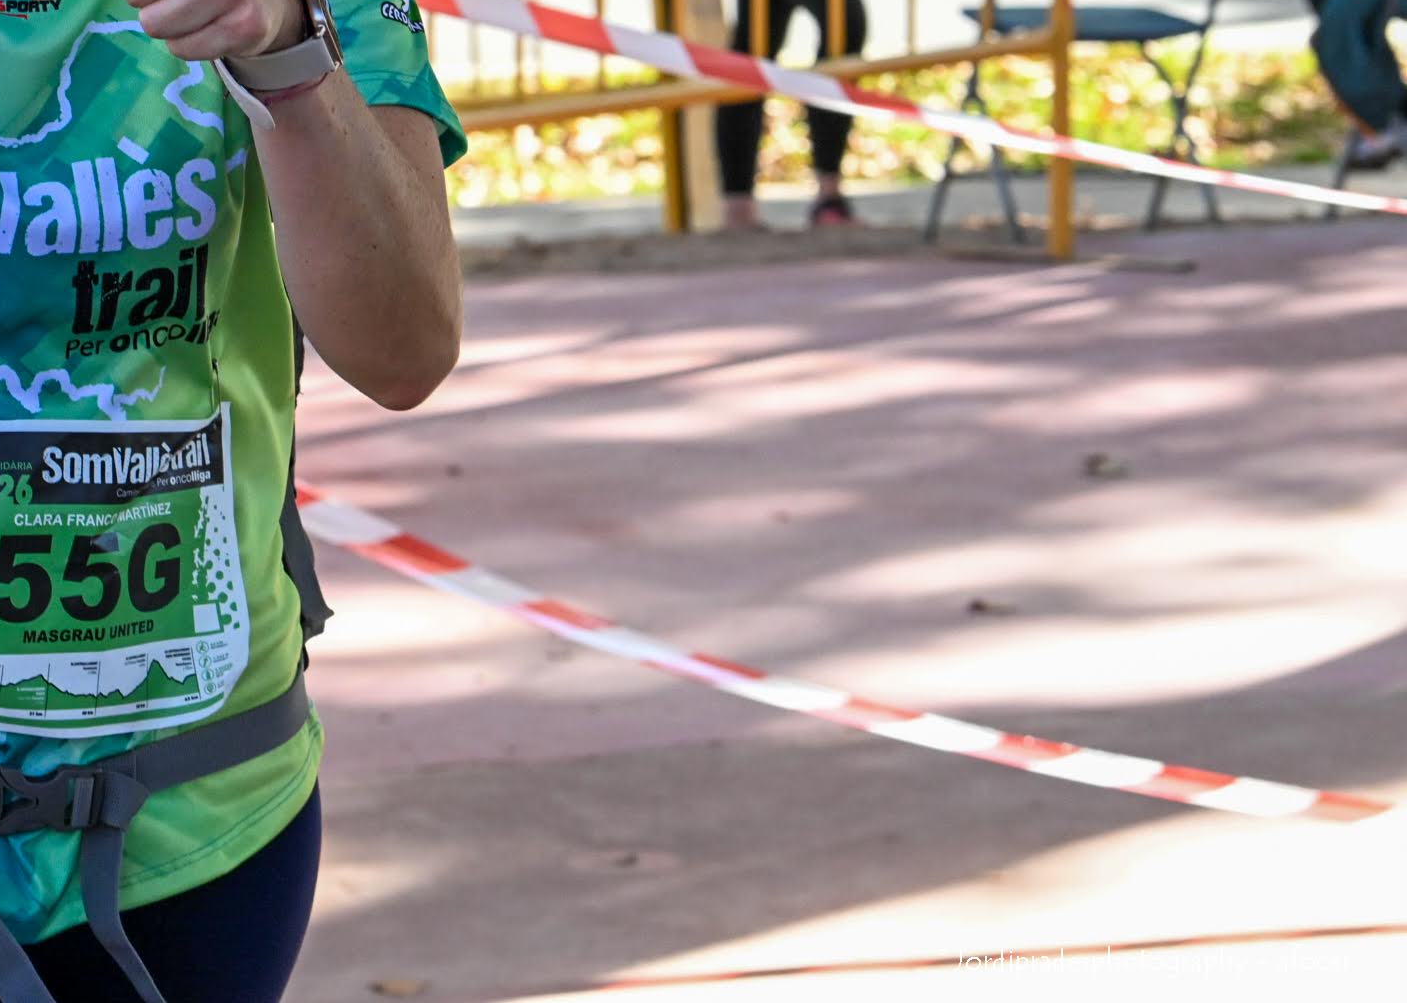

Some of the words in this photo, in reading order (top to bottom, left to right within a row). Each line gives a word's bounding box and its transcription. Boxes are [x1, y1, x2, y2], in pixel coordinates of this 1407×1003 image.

[71, 243, 209, 336] trail
[65, 339, 105, 359] Per
[14, 513, 63, 526] CLARA
[23, 628, 106, 644] MASGRAU
[109, 619, 155, 639] UNITED
